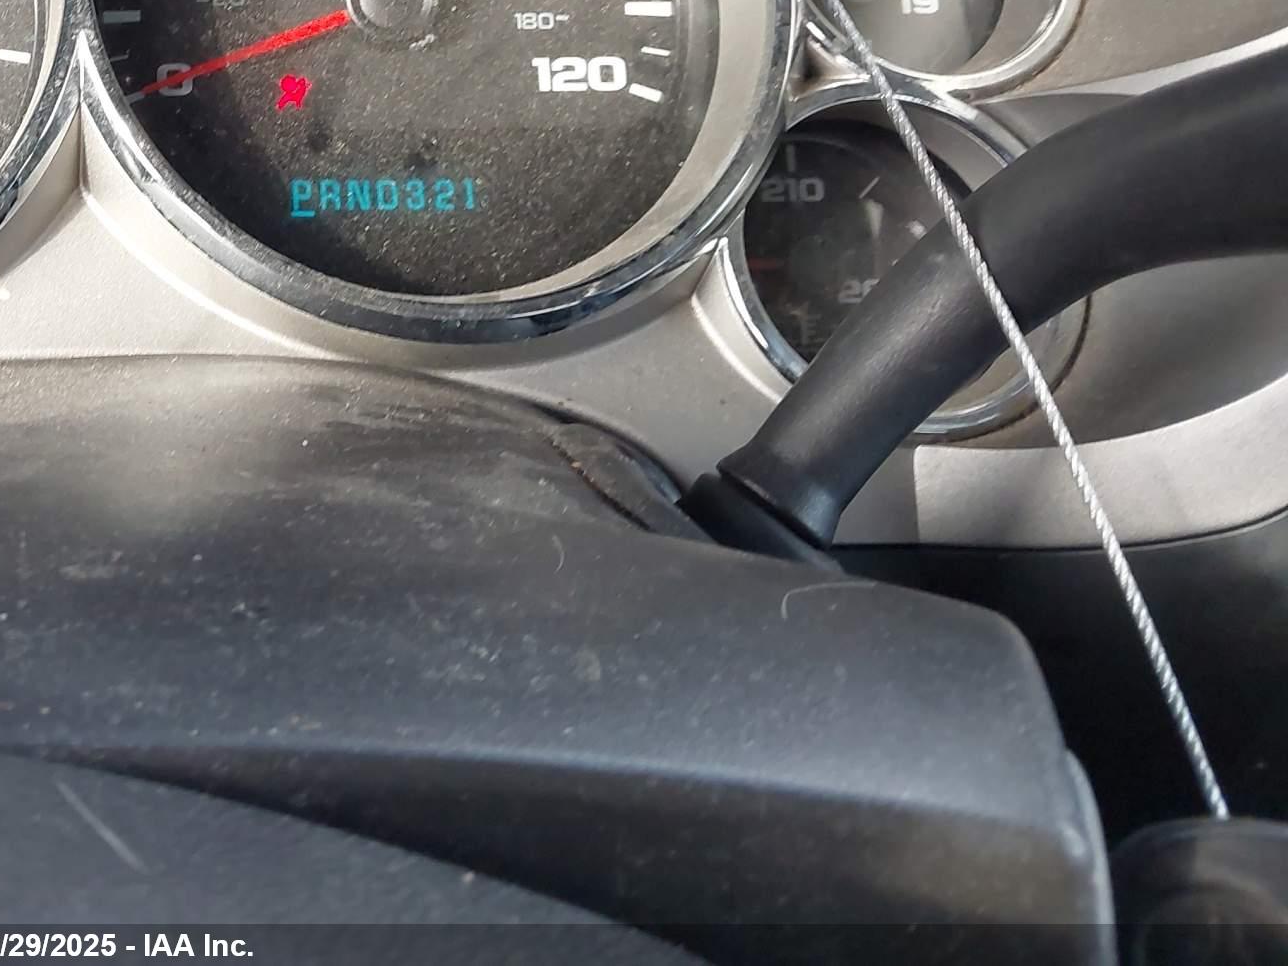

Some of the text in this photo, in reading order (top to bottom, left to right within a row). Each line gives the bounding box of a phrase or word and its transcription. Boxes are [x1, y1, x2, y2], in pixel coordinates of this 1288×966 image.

[514, 12, 555, 30] 180
[156, 63, 193, 97] 0
[531, 56, 627, 92] 120
[291, 178, 475, 214] PRND321
[761, 177, 825, 203] 210
